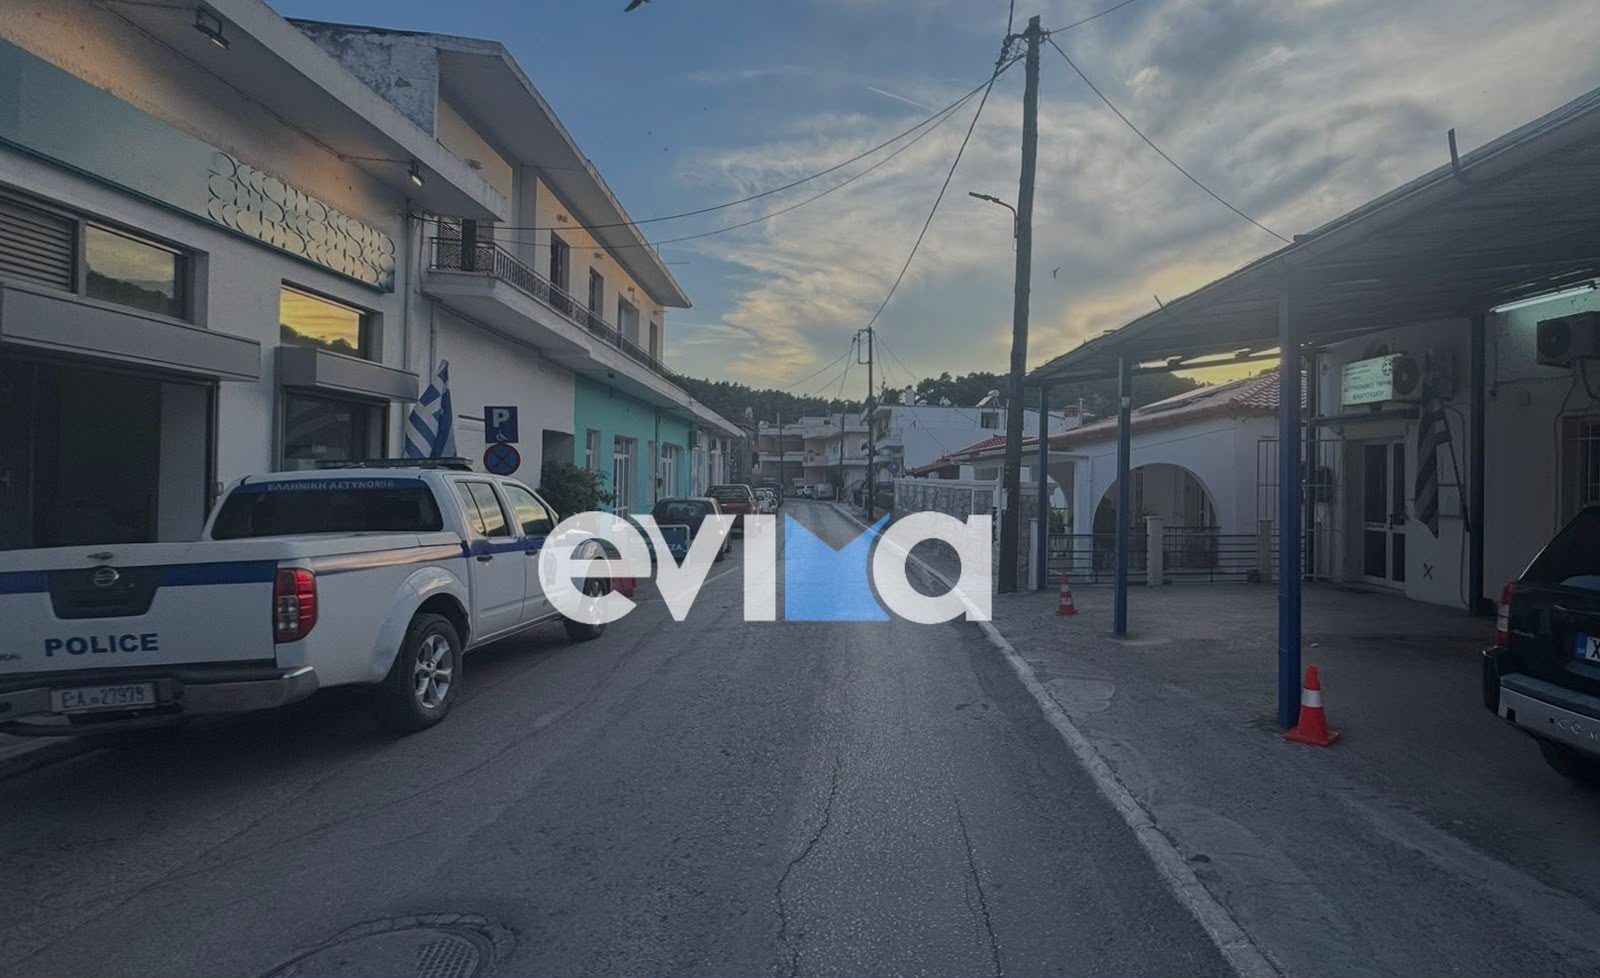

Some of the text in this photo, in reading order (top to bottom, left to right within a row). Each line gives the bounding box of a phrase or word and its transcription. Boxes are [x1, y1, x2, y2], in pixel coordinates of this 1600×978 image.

[492, 408, 510, 428] P
[267, 481, 328, 491] ΕΛΛΗΝΙΚΗ
[44, 633, 159, 657] POLICE
